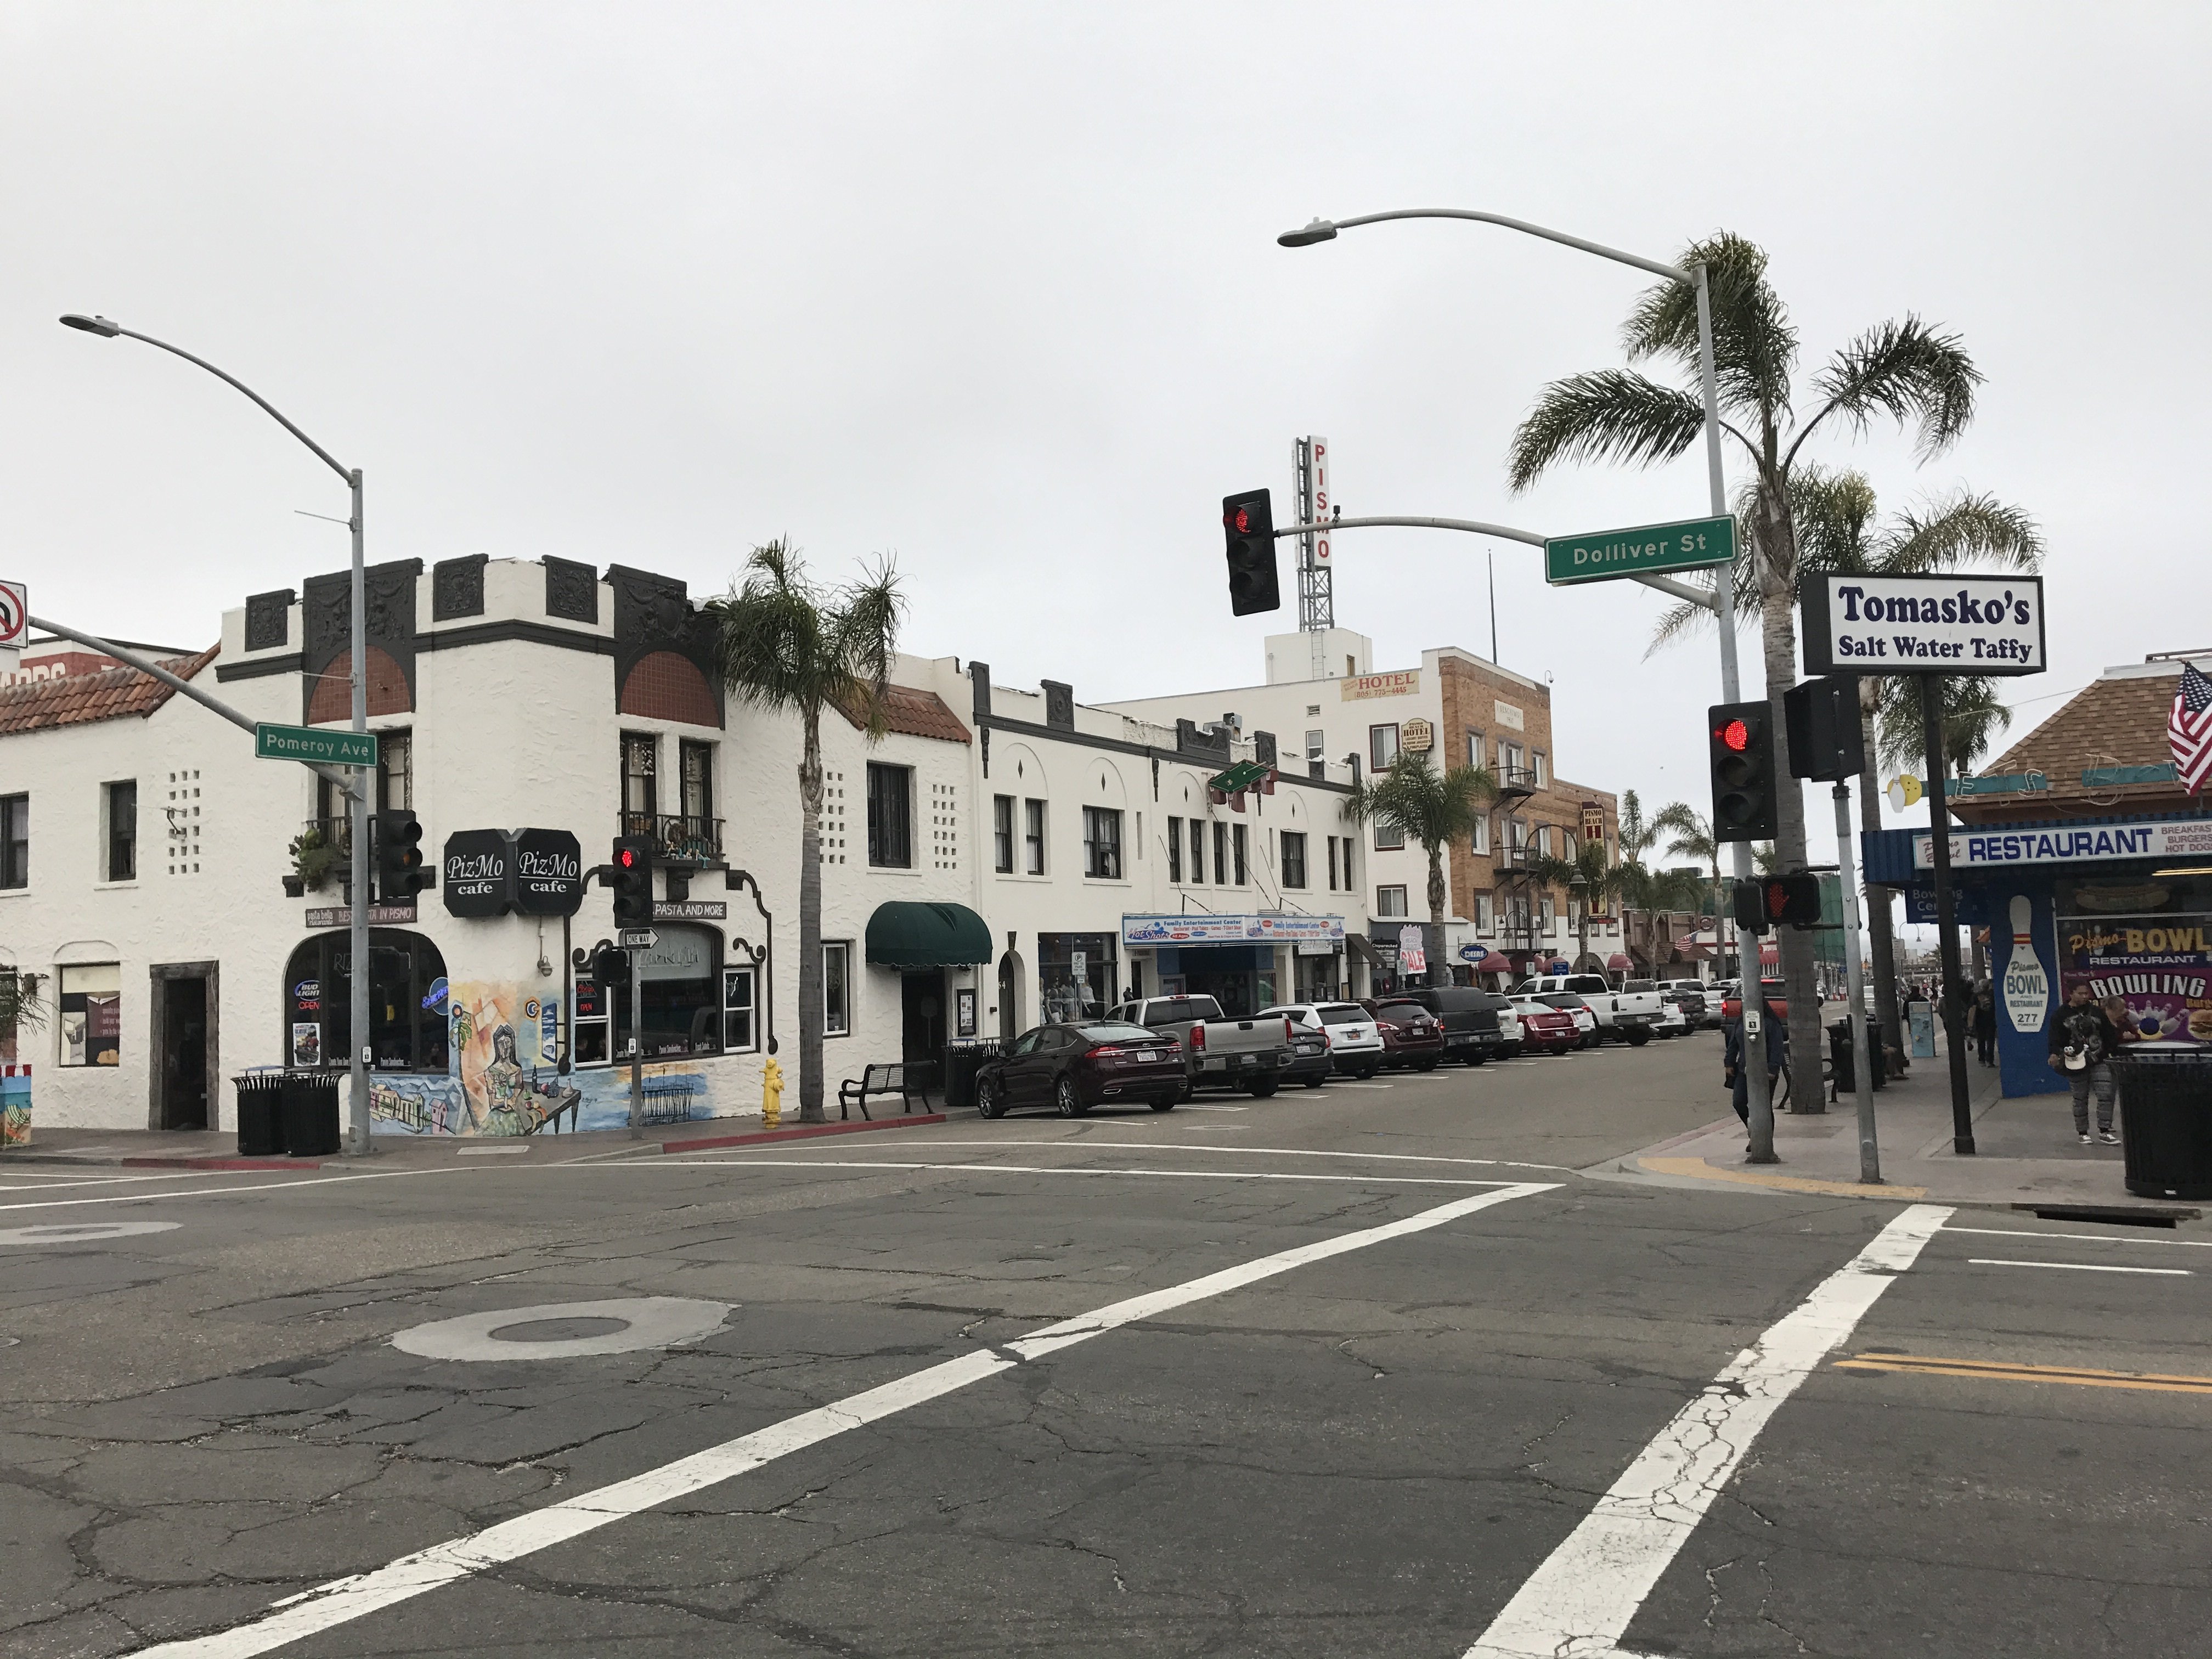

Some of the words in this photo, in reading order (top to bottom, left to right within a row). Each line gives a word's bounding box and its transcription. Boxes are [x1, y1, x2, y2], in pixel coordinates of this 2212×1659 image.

[1315, 444, 1329, 558] PISMO
[1574, 541, 1668, 565] Dolliver
[1680, 533, 1706, 552] St
[1838, 585, 2030, 625] Tomasko's
[1839, 635, 1887, 657] Salt
[1893, 636, 1963, 658] Water
[1970, 637, 2033, 663] Taffy
[1359, 673, 1415, 690] HOTEL
[1403, 727, 1430, 736] HOTEL
[267, 734, 334, 756] Pomeroy
[341, 742, 369, 756] Ave
[1968, 828, 2153, 861] RESTAURANT
[447, 853, 503, 878] PizMo
[519, 850, 577, 877] PizMo
[458, 882, 493, 895] cafe
[530, 880, 567, 893] cafe
[338, 911, 352, 923] BES
[379, 907, 387, 919] IN
[389, 907, 411, 919] PISMO
[655, 904, 685, 916] PASTA,
[686, 905, 703, 915] AND
[704, 905, 723, 916] MORE
[628, 935, 637, 943] ONE
[639, 934, 650, 943] WAY
[2126, 928, 2212, 953] BOWL
[2010, 961, 2039, 974] Pismo
[2089, 956, 2197, 965] RESTAURANT
[2007, 974, 2047, 994] BOWL
[2089, 974, 2206, 998] BOWLING
[298, 1001, 320, 1009] OPEN
[2017, 1013, 2038, 1023] 277
